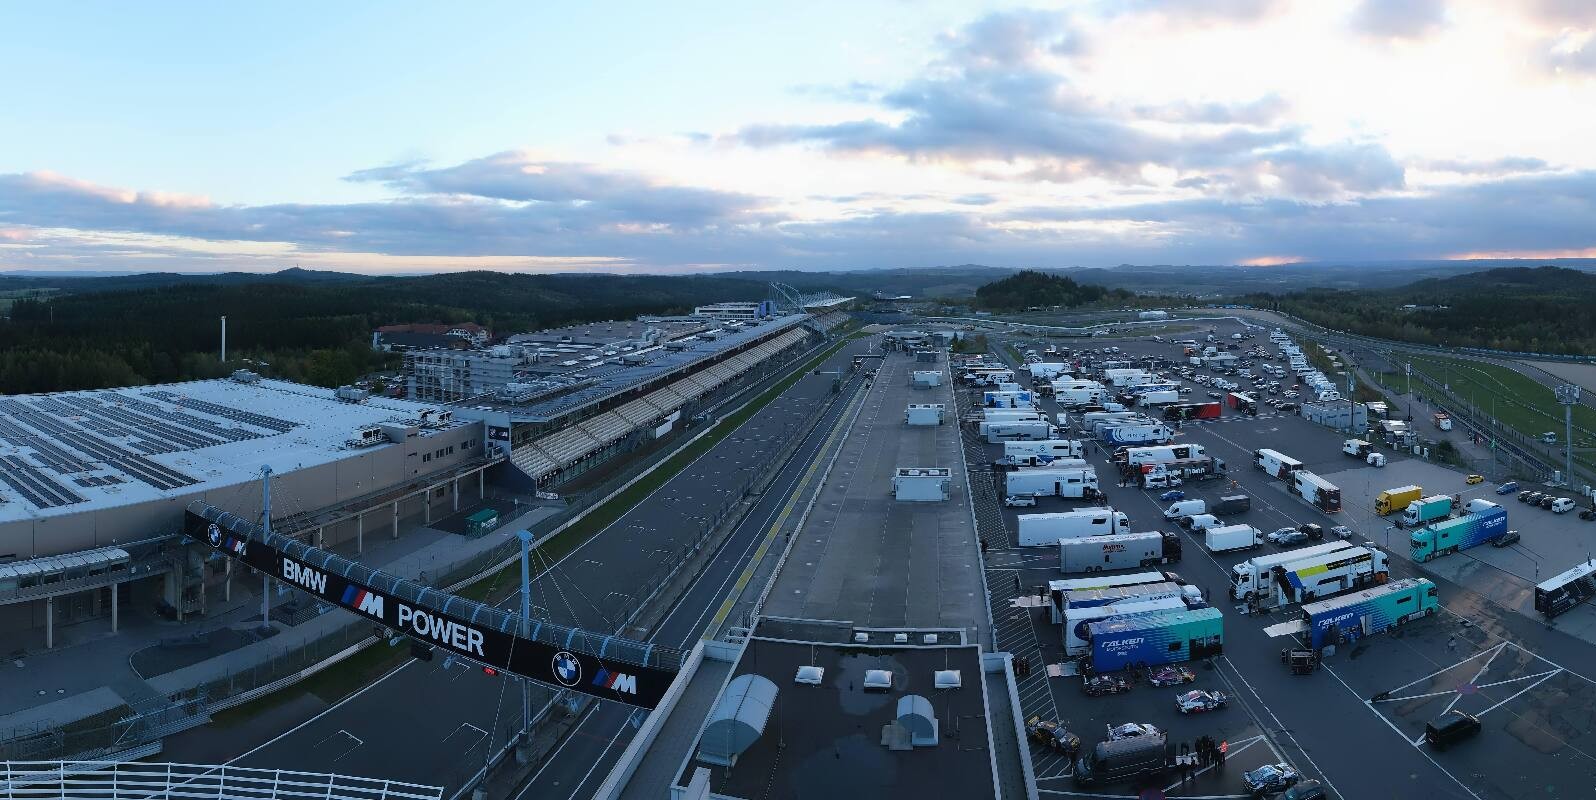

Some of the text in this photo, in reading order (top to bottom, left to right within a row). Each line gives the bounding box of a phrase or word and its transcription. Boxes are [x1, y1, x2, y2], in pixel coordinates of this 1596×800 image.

[283, 557, 327, 594] BMW
[398, 603, 485, 657] POWER
[1101, 637, 1145, 648] FALKEN
